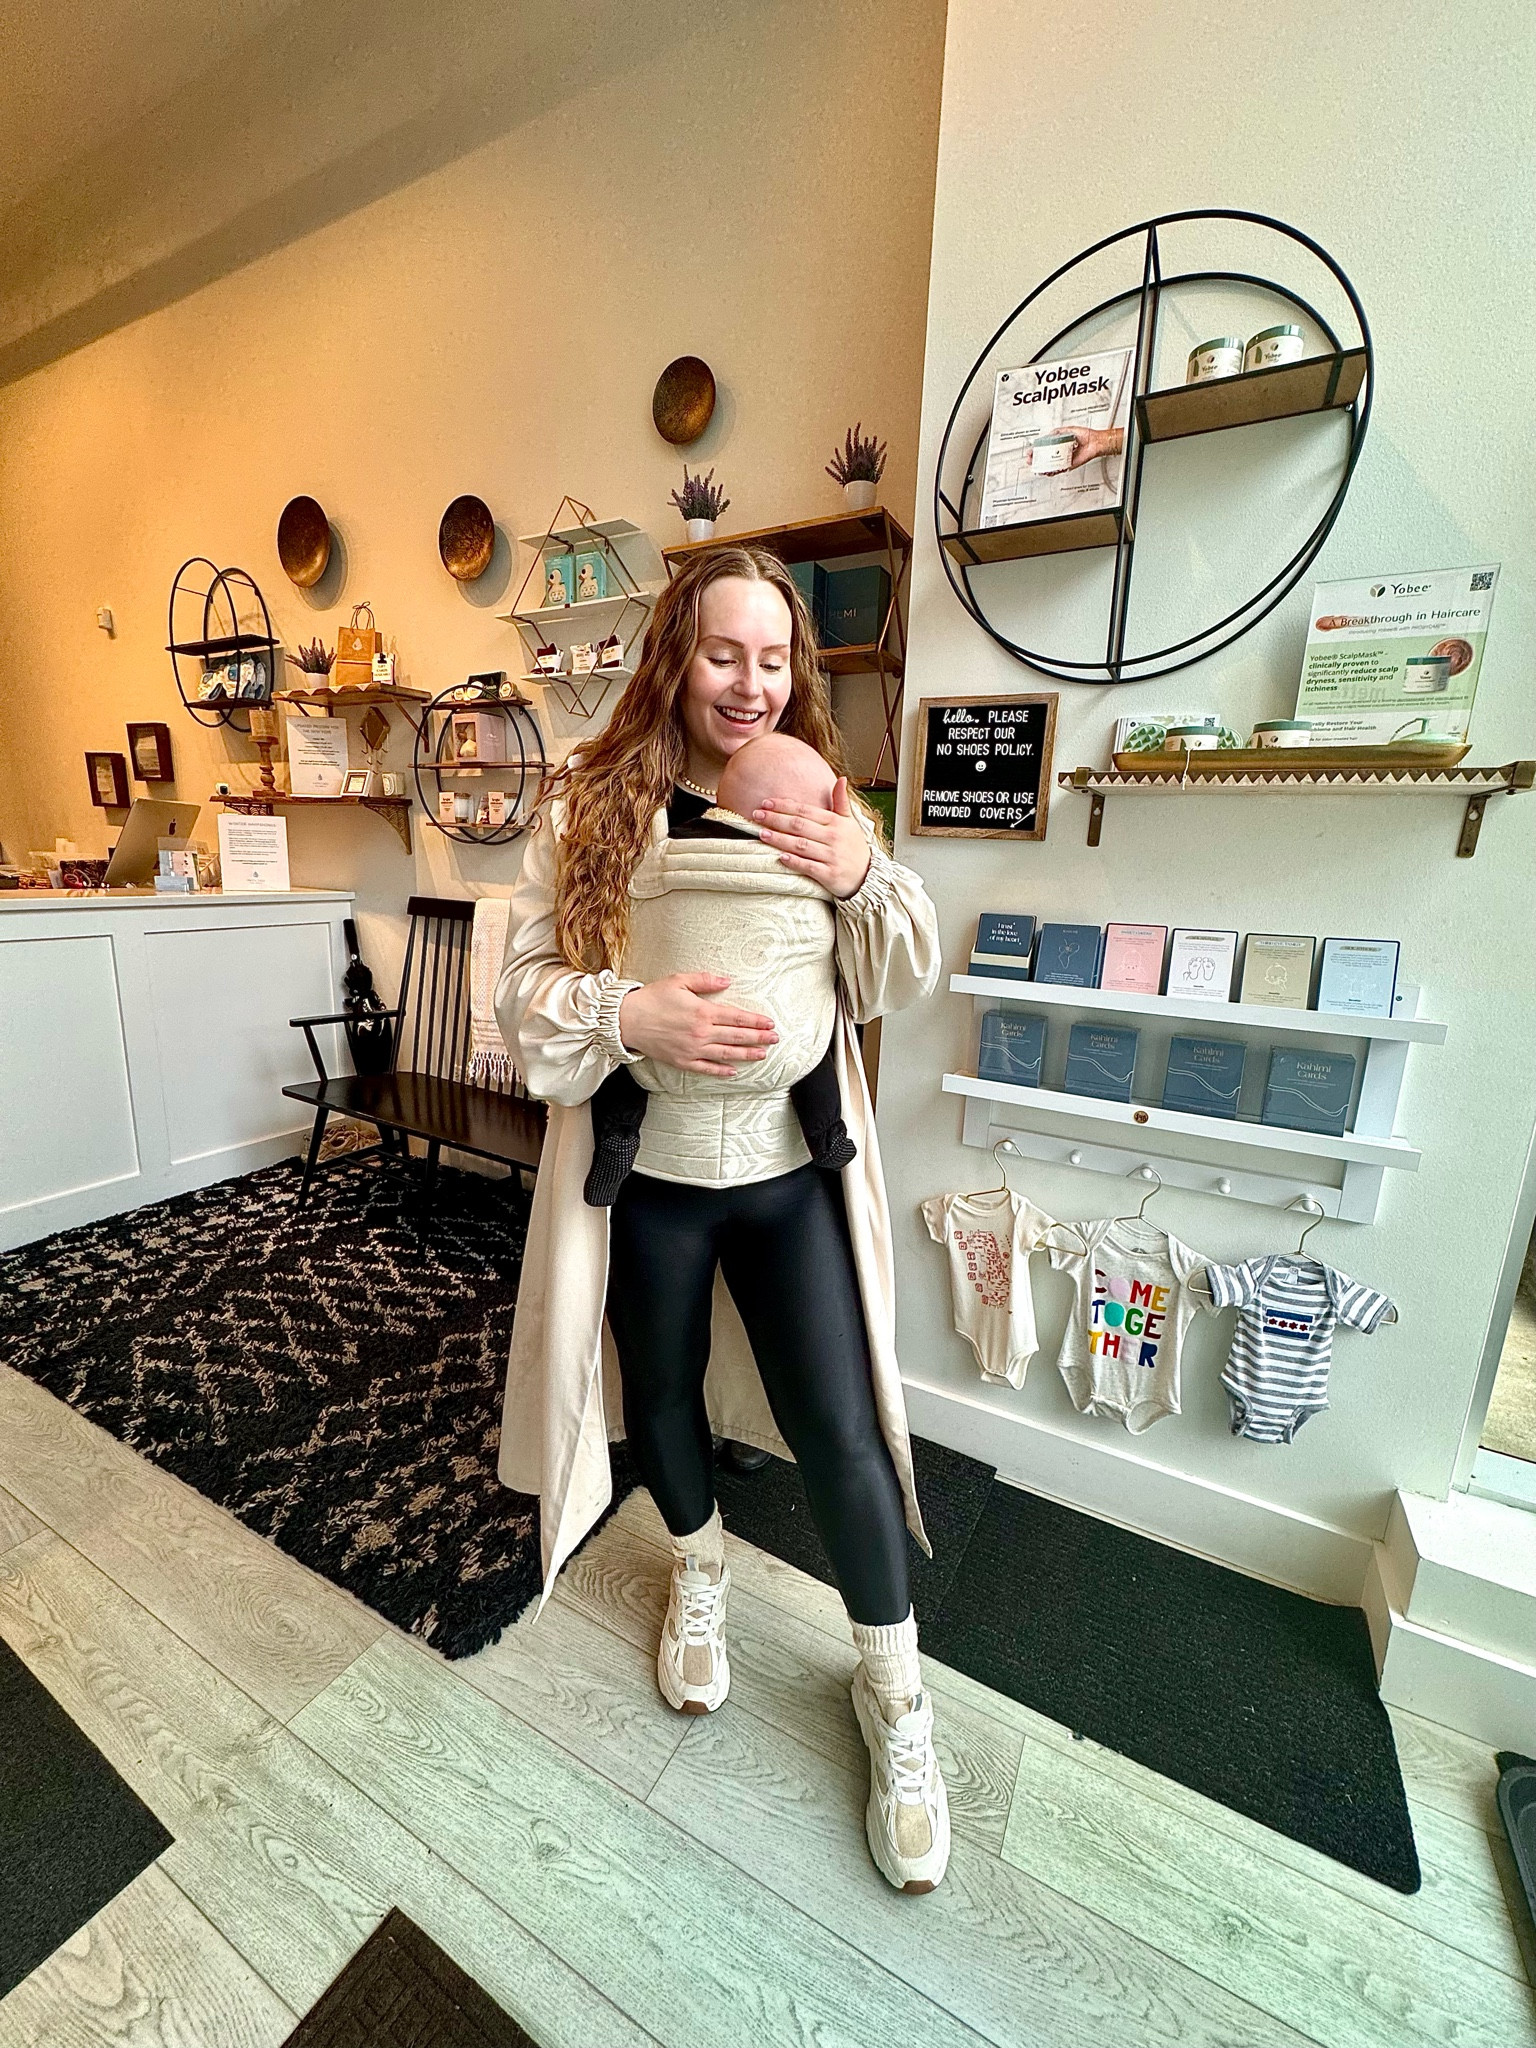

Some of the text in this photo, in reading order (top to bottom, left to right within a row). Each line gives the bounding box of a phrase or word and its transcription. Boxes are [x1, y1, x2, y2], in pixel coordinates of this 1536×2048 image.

[1034, 364, 1091, 386] Yobee
[1012, 375, 1110, 406] ScalpMask
[1329, 619, 1336, 627] A
[1340, 612, 1412, 627] Breakthrough
[1416, 611, 1427, 620] in
[1431, 609, 1481, 619] Haircare
[1308, 661, 1341, 669] clinically
[1307, 669, 1350, 678] significantly
[1338, 675, 1377, 683] sensitivity
[988, 710, 1029, 723] PLEASE
[948, 727, 1015, 740] RESPECT OUR
[936, 743, 1035, 756] NO SHOES POLICY.
[923, 789, 1035, 805] REMOVE SHOES OR USE
[928, 805, 1023, 820] PROVIDED COVERS
[1091, 1041, 1116, 1049] Cards
[1194, 1054, 1220, 1063] Cards
[1297, 1070, 1327, 1080] Cards
[1092, 1299, 1166, 1340] TOGE
[1088, 1329, 1158, 1368] THER
